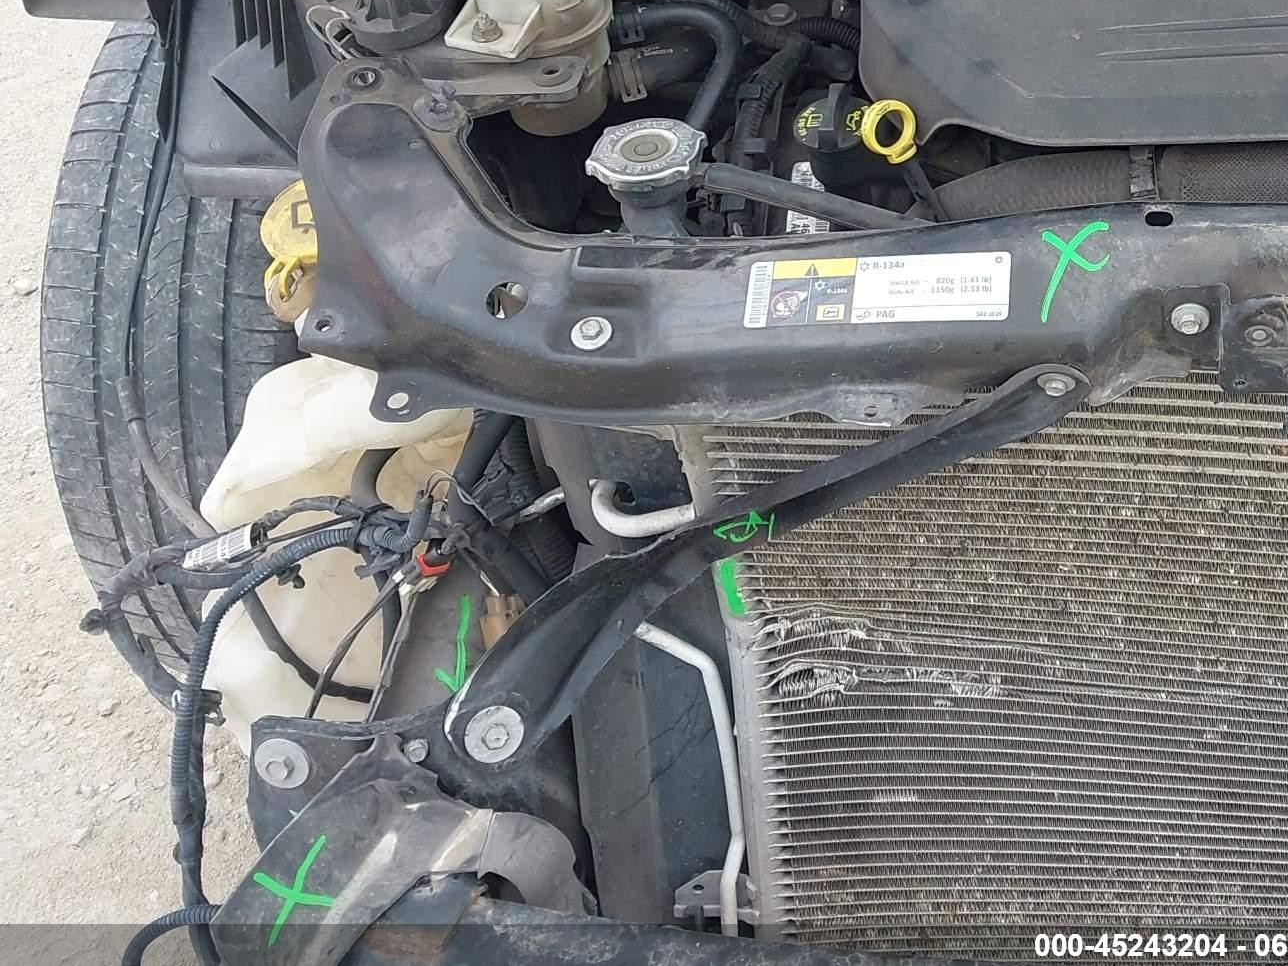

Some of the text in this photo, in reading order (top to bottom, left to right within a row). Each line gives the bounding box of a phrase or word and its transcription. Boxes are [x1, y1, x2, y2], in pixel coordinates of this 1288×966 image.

[936, 277, 955, 285] 820g
[981, 275, 992, 284] lb)
[876, 310, 896, 318] PAG
